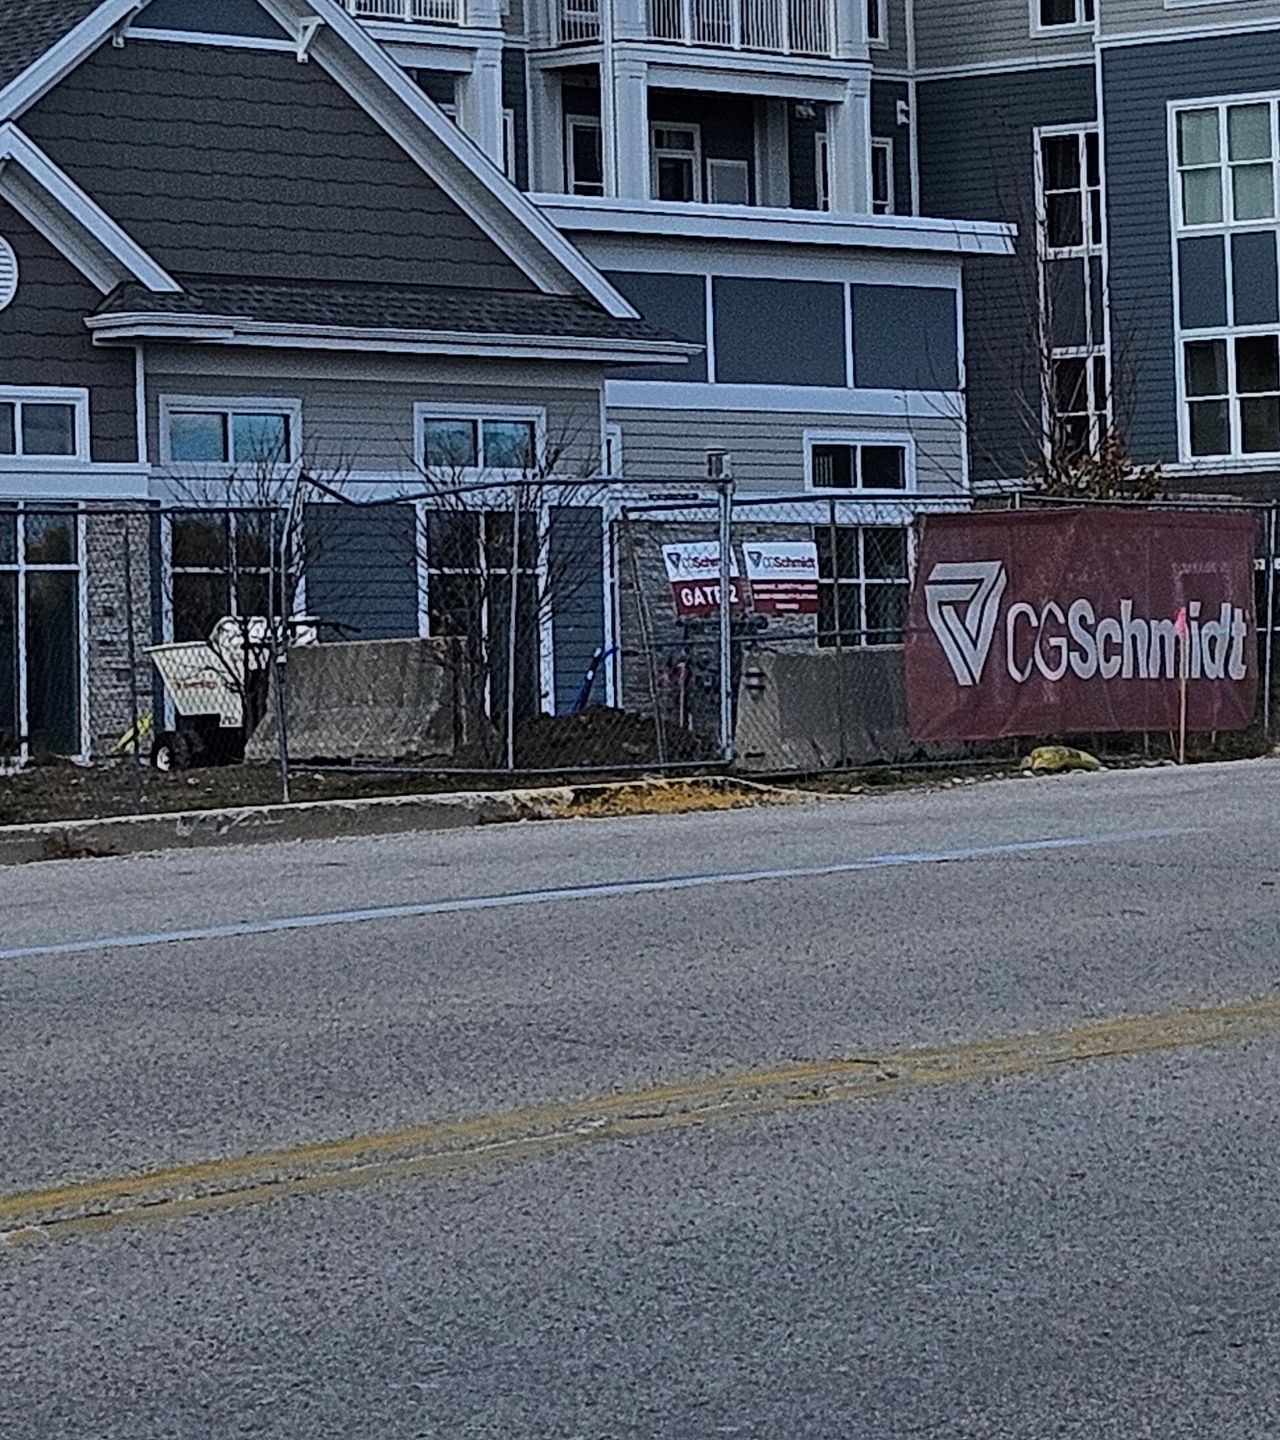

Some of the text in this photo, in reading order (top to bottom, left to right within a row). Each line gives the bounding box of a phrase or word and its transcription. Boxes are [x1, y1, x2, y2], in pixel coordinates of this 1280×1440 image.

[763, 556, 816, 569] CGSchmidt
[728, 584, 739, 603] 2
[1007, 598, 1248, 683] CGSchmidt
